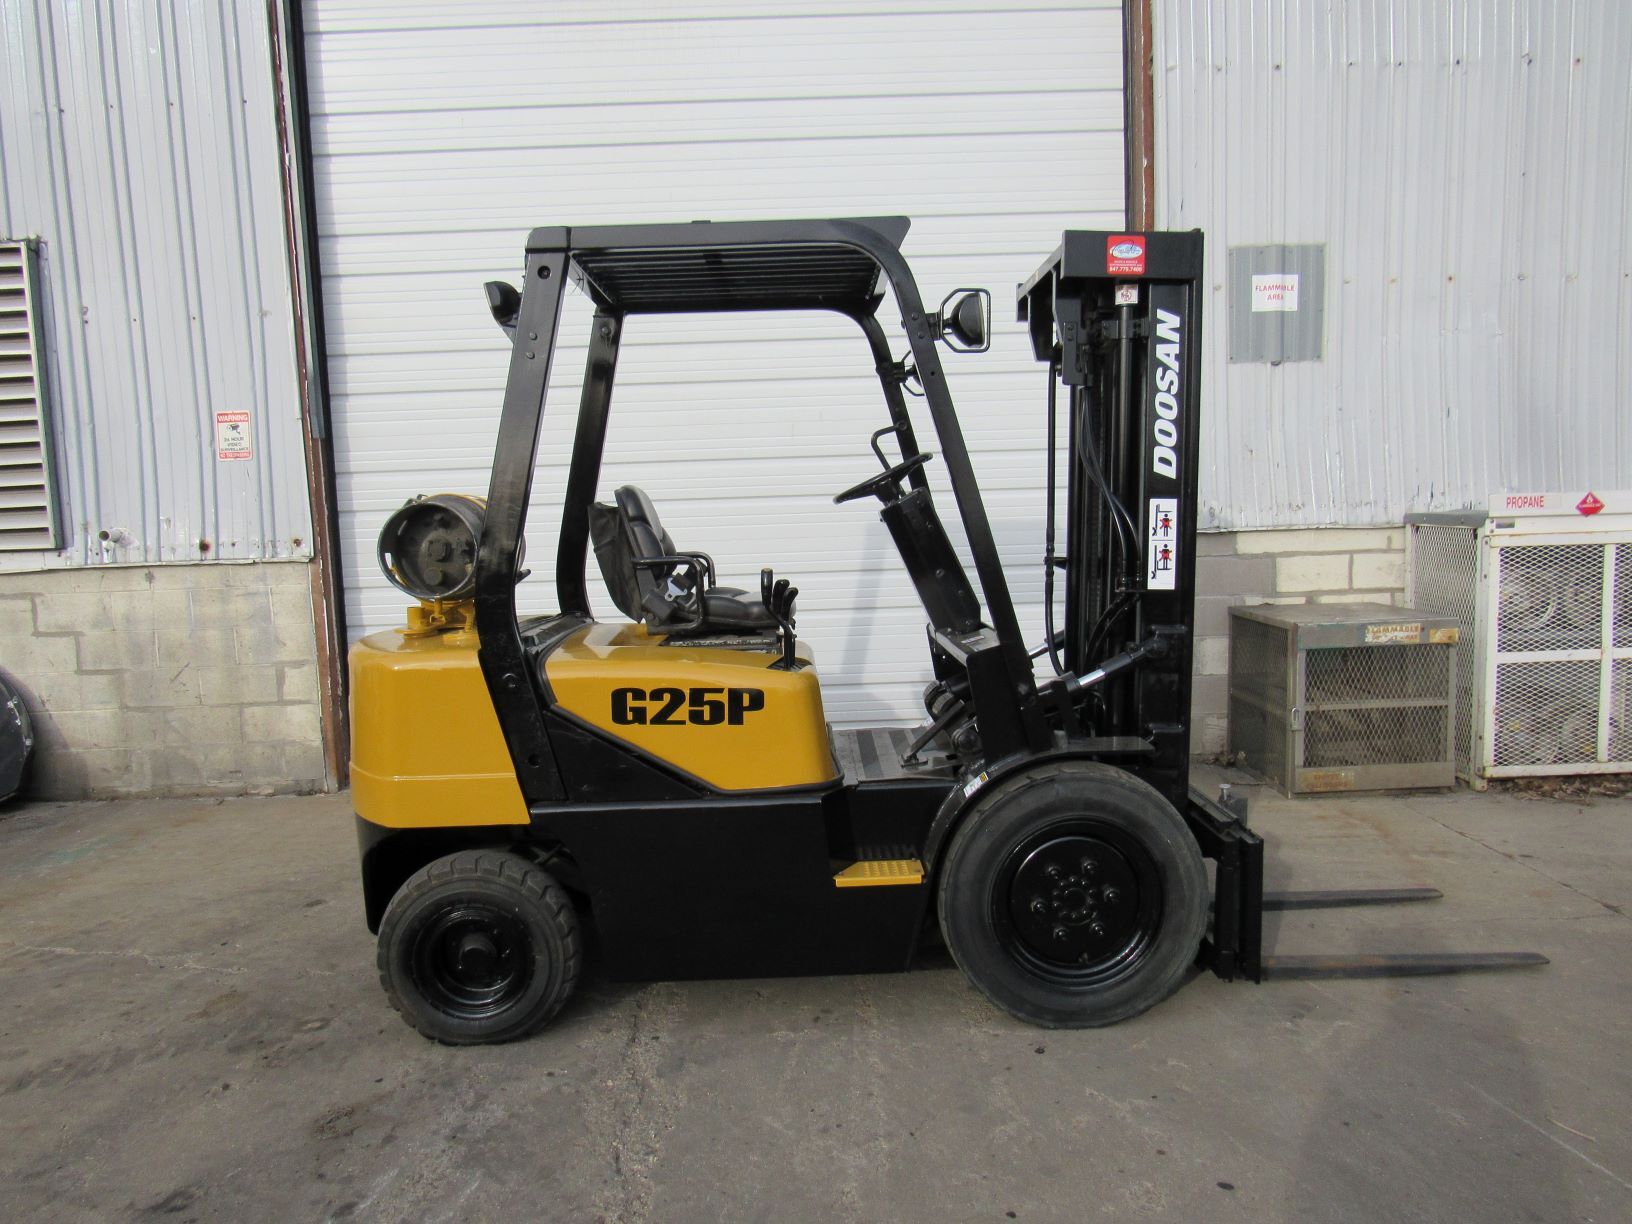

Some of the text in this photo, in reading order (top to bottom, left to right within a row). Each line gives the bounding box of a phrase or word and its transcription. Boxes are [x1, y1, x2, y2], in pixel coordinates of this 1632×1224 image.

[1153, 308, 1181, 480] DOOSAN
[1506, 495, 1545, 509] PROPANE
[611, 687, 765, 725] G25P
